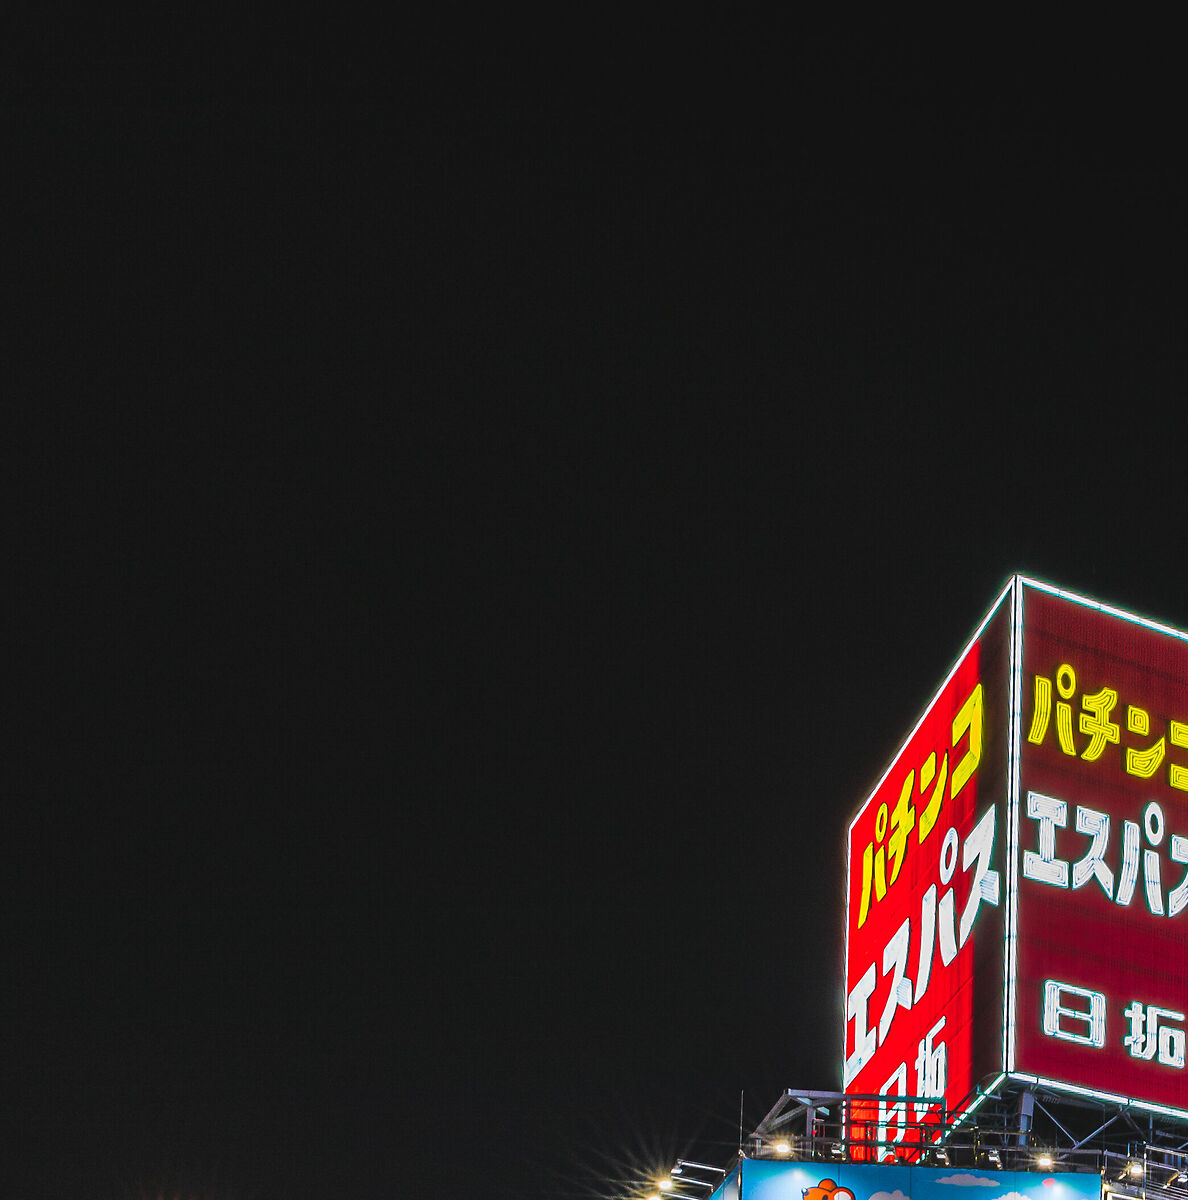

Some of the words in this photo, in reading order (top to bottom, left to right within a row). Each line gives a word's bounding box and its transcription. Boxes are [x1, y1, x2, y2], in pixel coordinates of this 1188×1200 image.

[858, 683, 983, 929] パチンコ
[847, 803, 1000, 1080] エスパス
[1043, 979, 1187, 1069] 日拓
